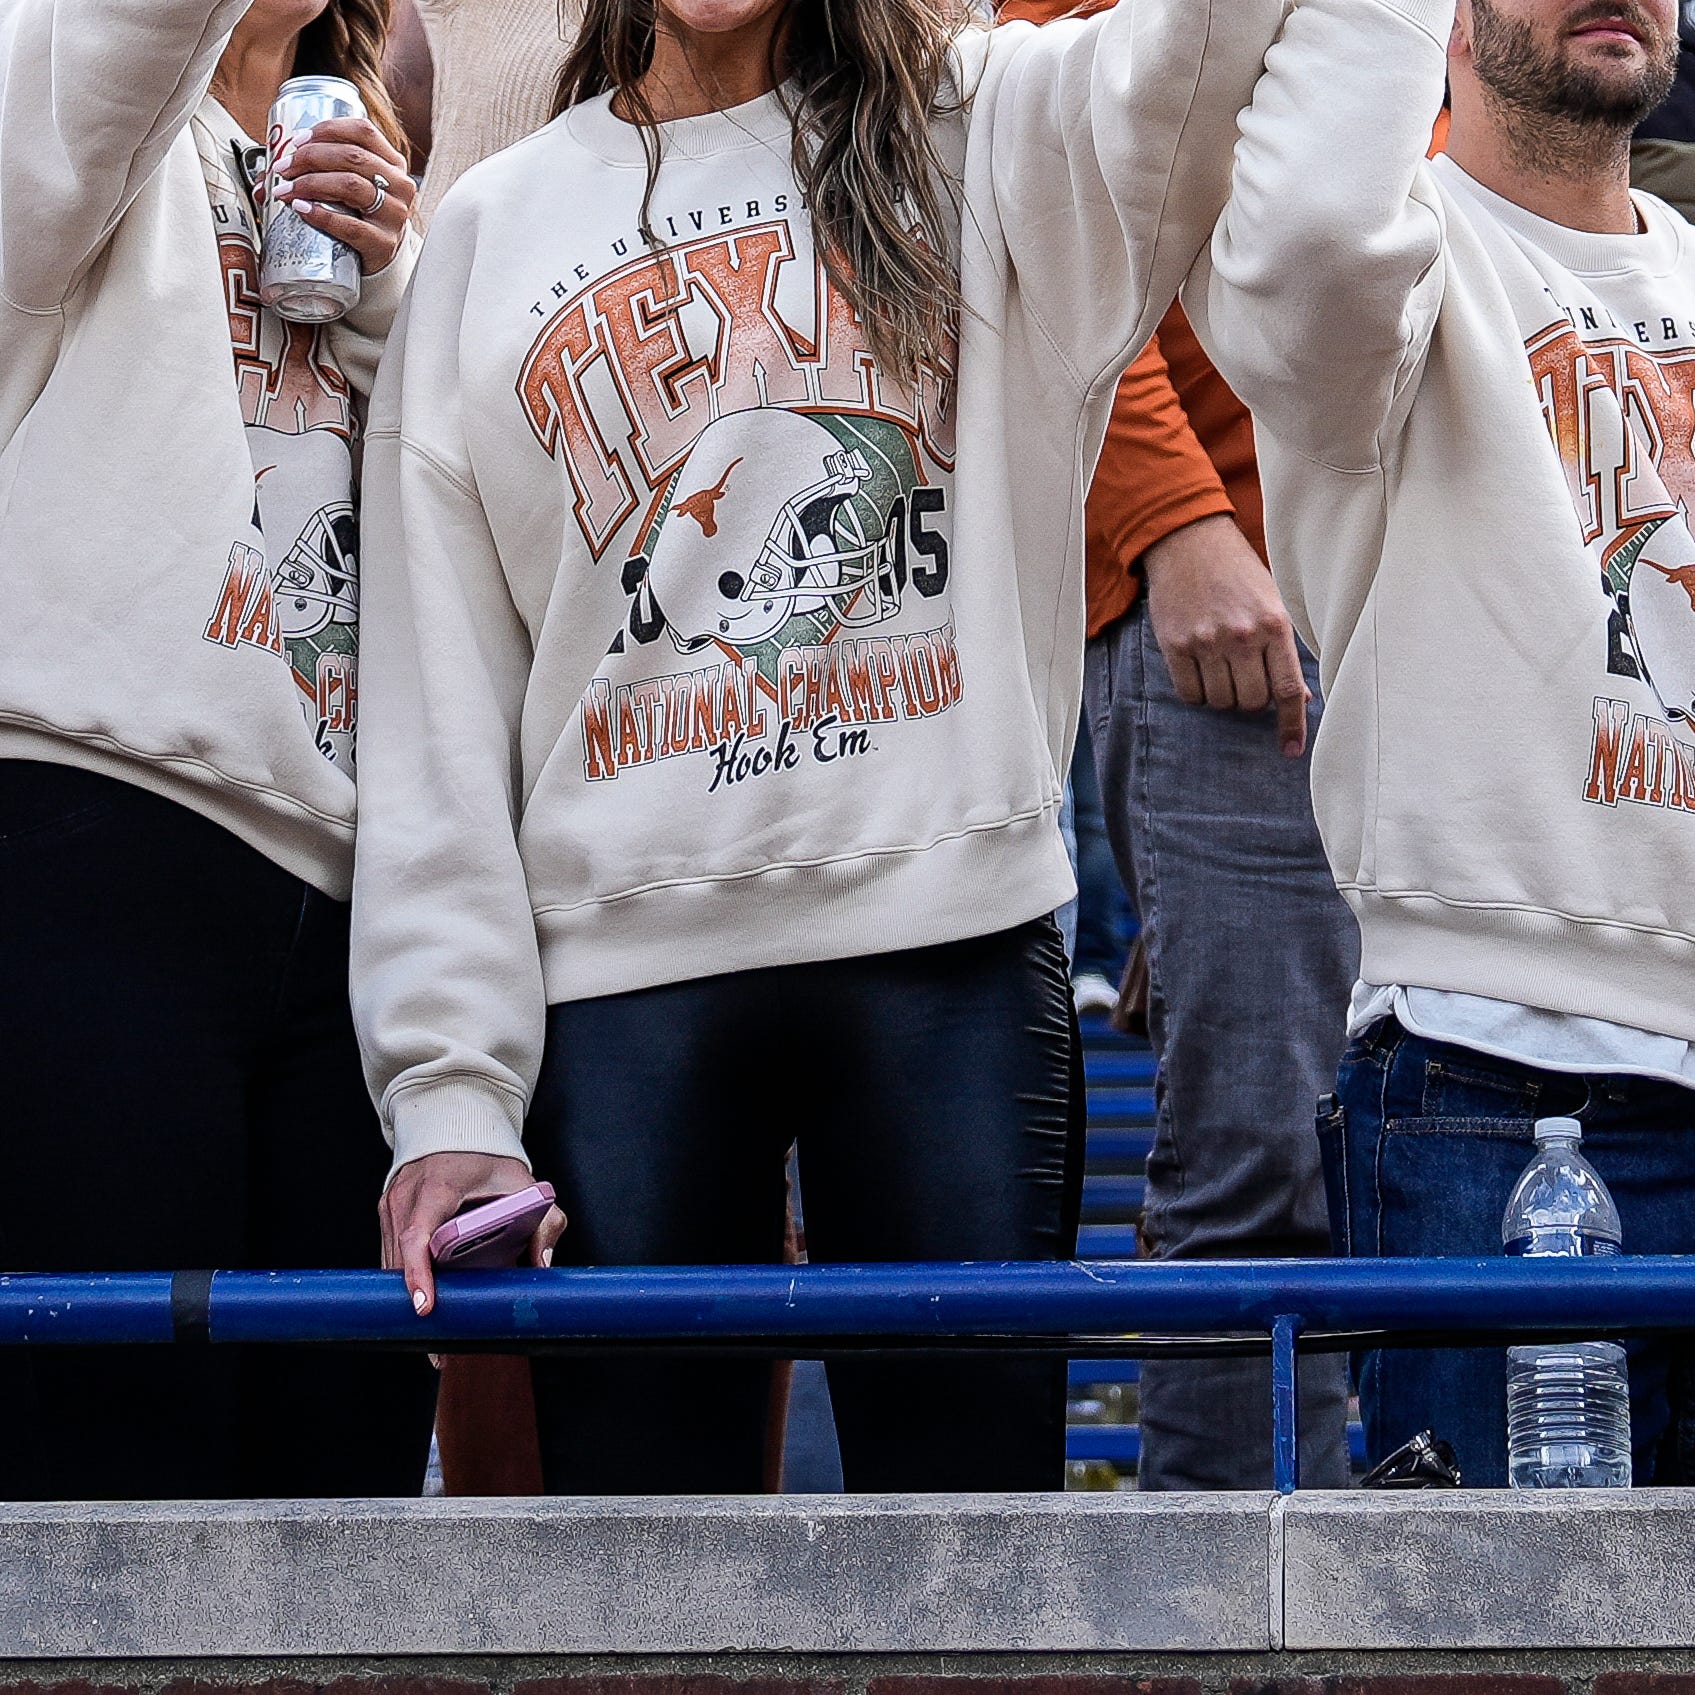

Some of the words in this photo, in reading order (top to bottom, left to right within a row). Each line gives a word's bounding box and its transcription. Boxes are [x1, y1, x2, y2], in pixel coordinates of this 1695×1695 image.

[529, 263, 590, 318] THE
[580, 654, 769, 783] NATIONAL
[707, 721, 801, 794] Hook
